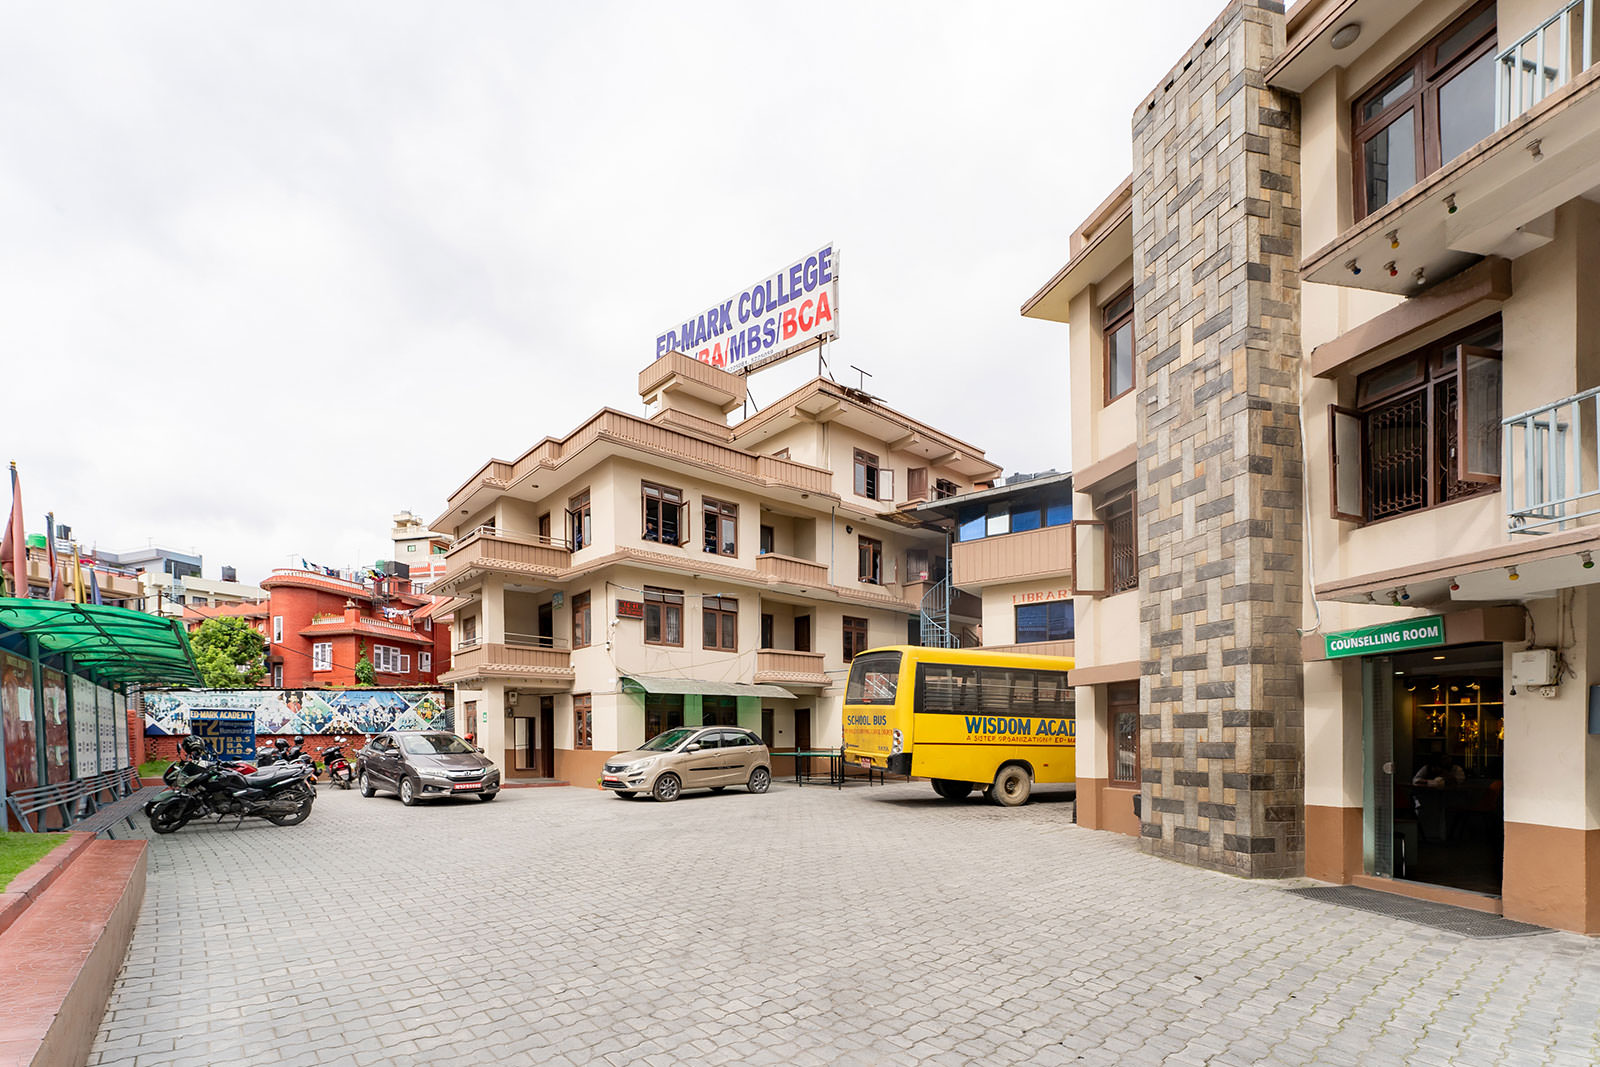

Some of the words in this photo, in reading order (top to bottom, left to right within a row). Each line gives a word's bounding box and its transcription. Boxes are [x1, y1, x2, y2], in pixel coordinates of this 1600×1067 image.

[738, 246, 832, 325] COLLEGE
[1330, 631, 1401, 651] COUNSELLING
[1403, 625, 1439, 641] ROOM
[219, 711, 254, 720] ACADEMY
[847, 715, 871, 726] SCHOOL
[873, 715, 887, 726] BUS
[964, 716, 1031, 736] WISDOM
